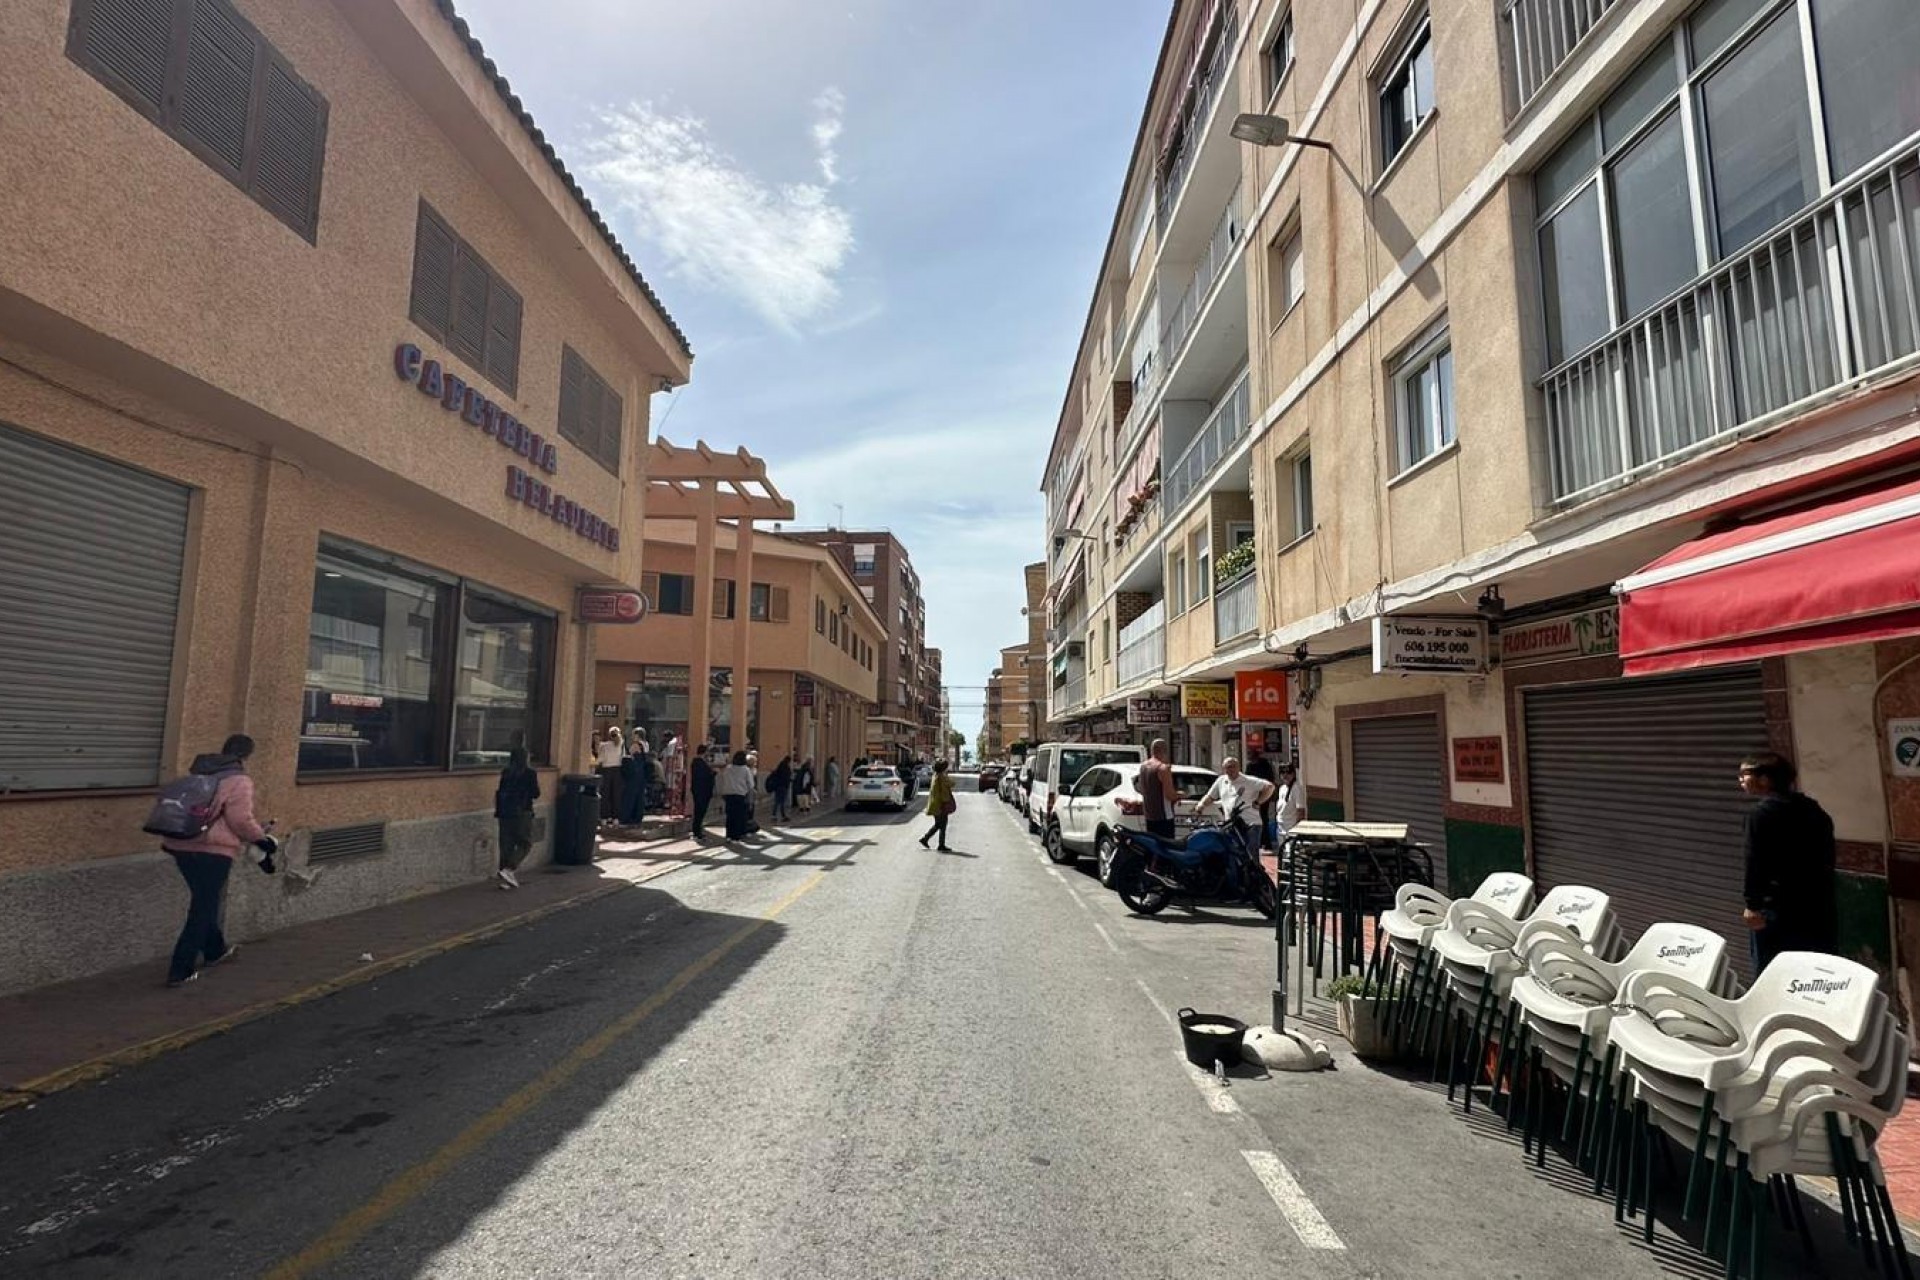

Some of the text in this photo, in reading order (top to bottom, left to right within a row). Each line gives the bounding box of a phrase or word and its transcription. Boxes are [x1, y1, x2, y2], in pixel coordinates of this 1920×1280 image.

[394, 343, 557, 475] CAFETERIA
[1434, 627, 1453, 637] For
[1455, 627, 1478, 637] Sale
[1503, 622, 1572, 653] FLORISTERIA
[1404, 641, 1469, 653] 606 195 000
[1244, 680, 1280, 703] ria
